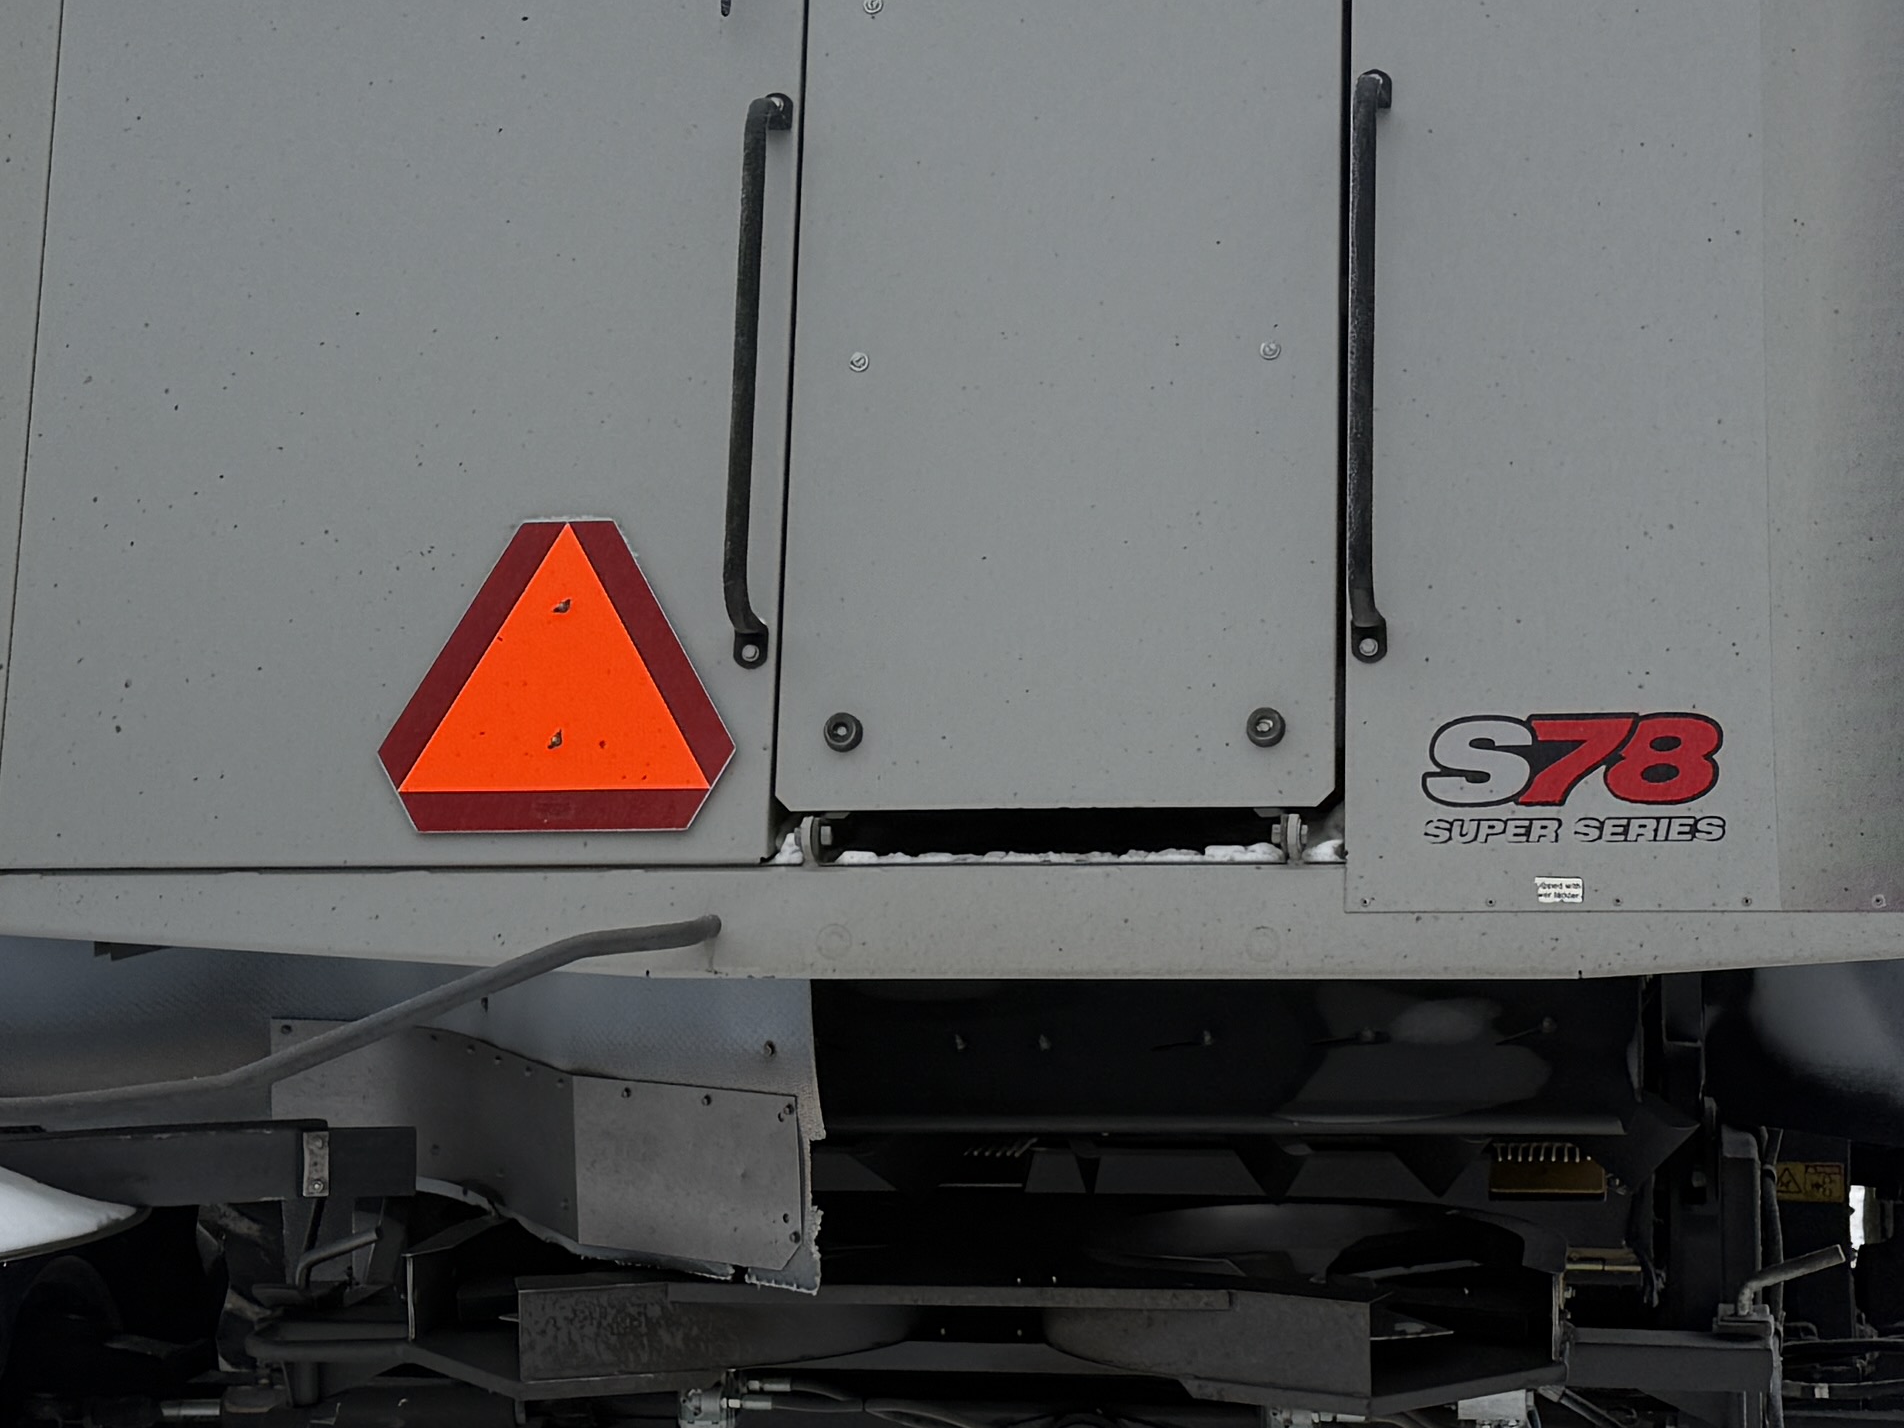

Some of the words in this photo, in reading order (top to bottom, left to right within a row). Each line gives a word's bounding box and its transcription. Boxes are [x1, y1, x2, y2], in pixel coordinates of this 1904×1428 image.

[1421, 712, 1723, 807] S78
[1424, 818, 1562, 844] SUPER
[1574, 816, 1726, 843] SERIES
